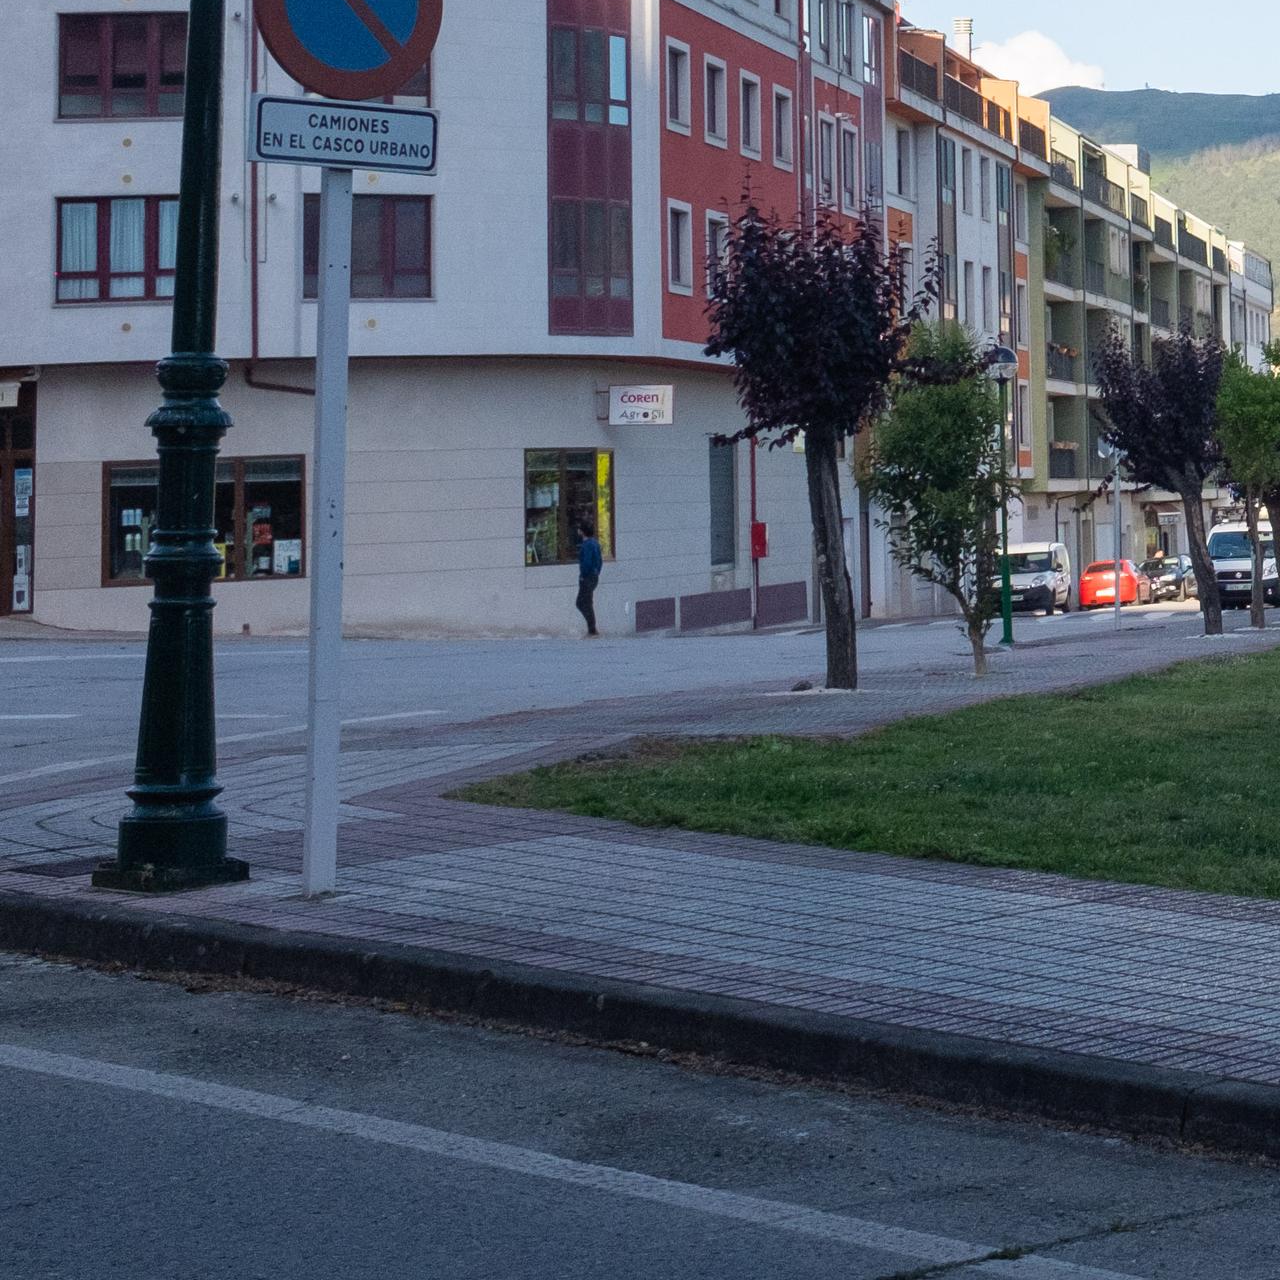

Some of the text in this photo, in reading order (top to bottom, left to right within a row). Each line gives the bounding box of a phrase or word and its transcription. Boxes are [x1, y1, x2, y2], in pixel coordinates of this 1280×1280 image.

[308, 113, 390, 134] CAMIONES
[263, 132, 431, 159] EN EL CASCO URBANO
